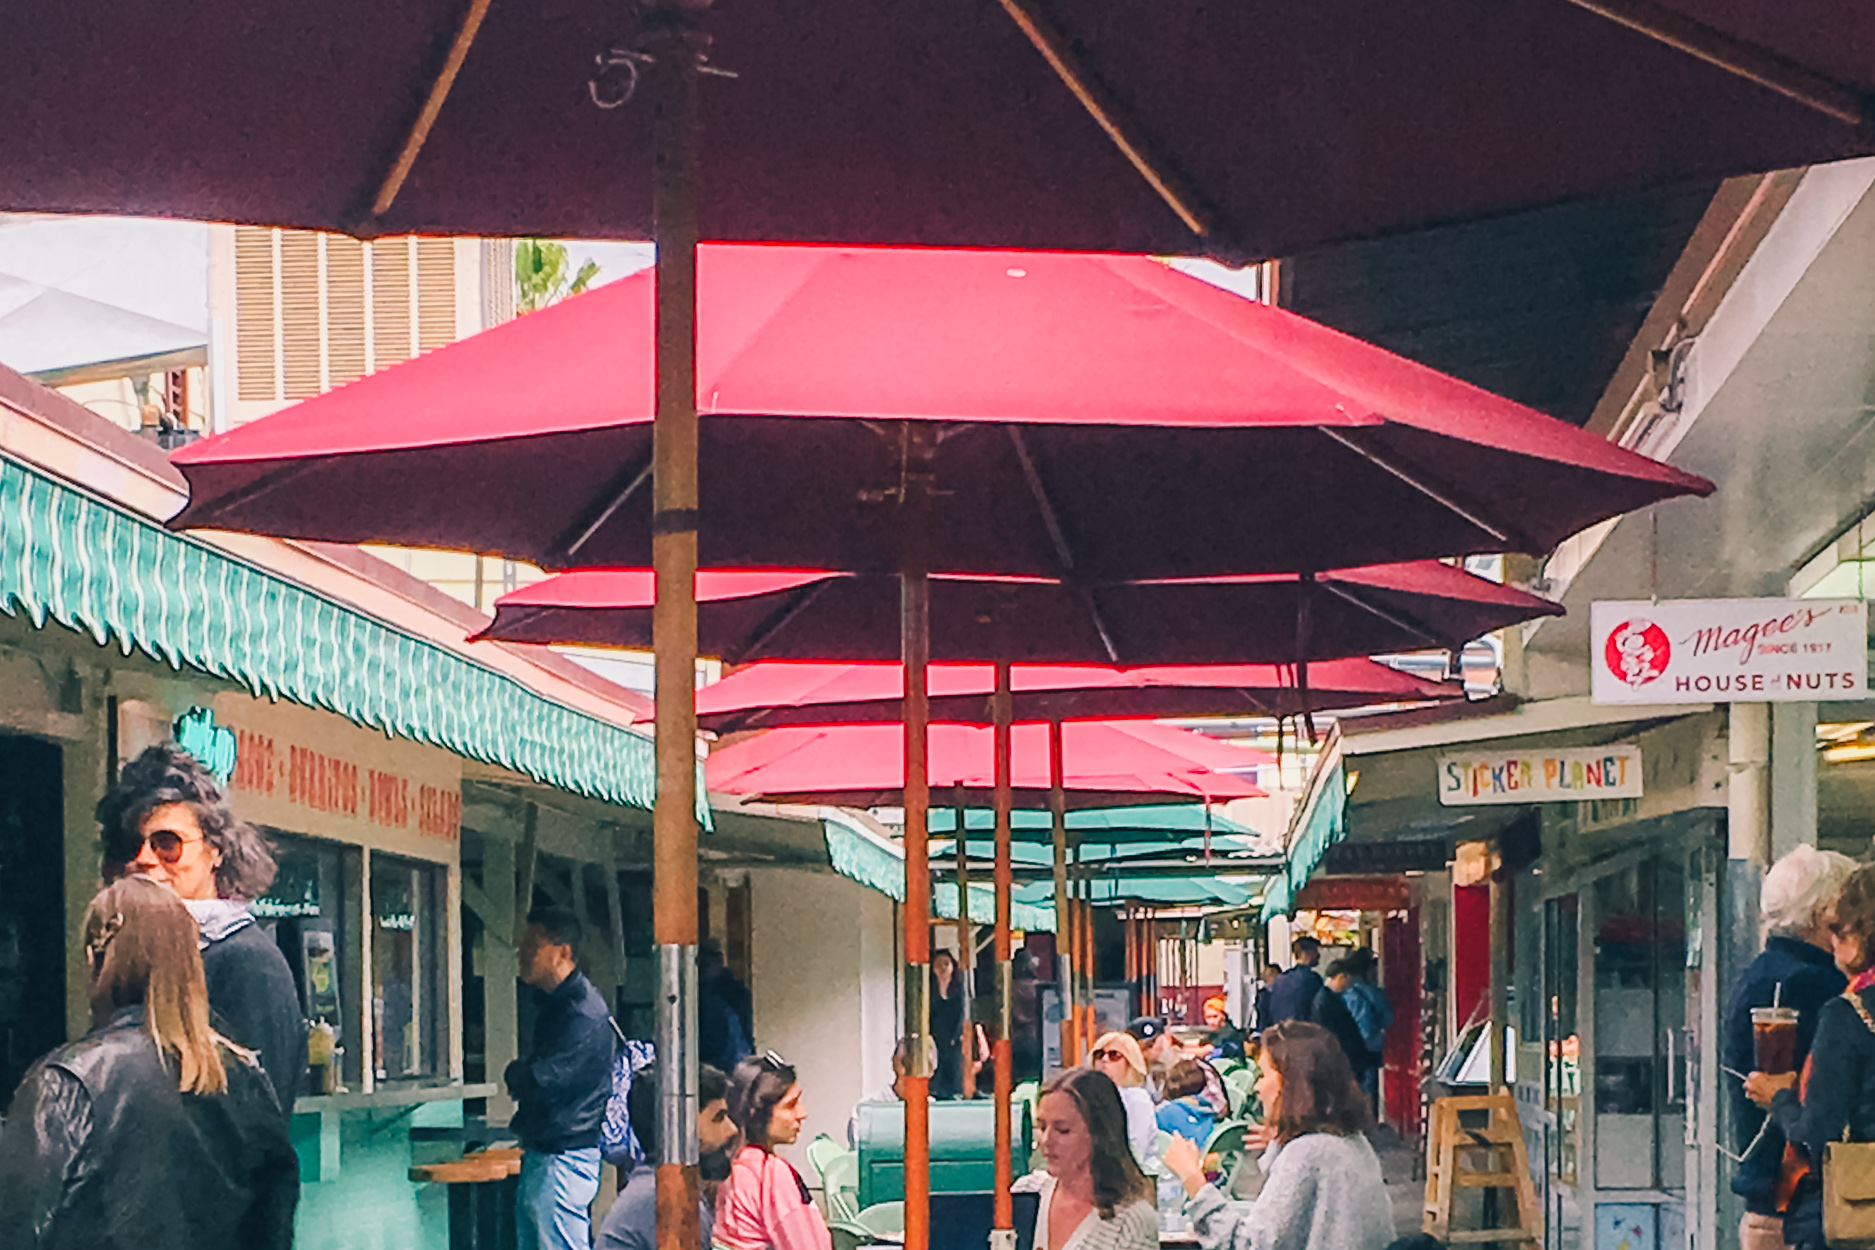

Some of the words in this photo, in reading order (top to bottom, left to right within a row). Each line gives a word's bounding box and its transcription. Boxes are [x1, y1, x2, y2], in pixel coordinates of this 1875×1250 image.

[1678, 608, 1832, 665] Magee's
[1757, 642, 1798, 655] SINCE
[1675, 674, 1765, 692] HOUSE
[1786, 672, 1855, 690] NUTS
[1447, 760, 1533, 797] STICKER
[1543, 756, 1630, 790] PLANET
